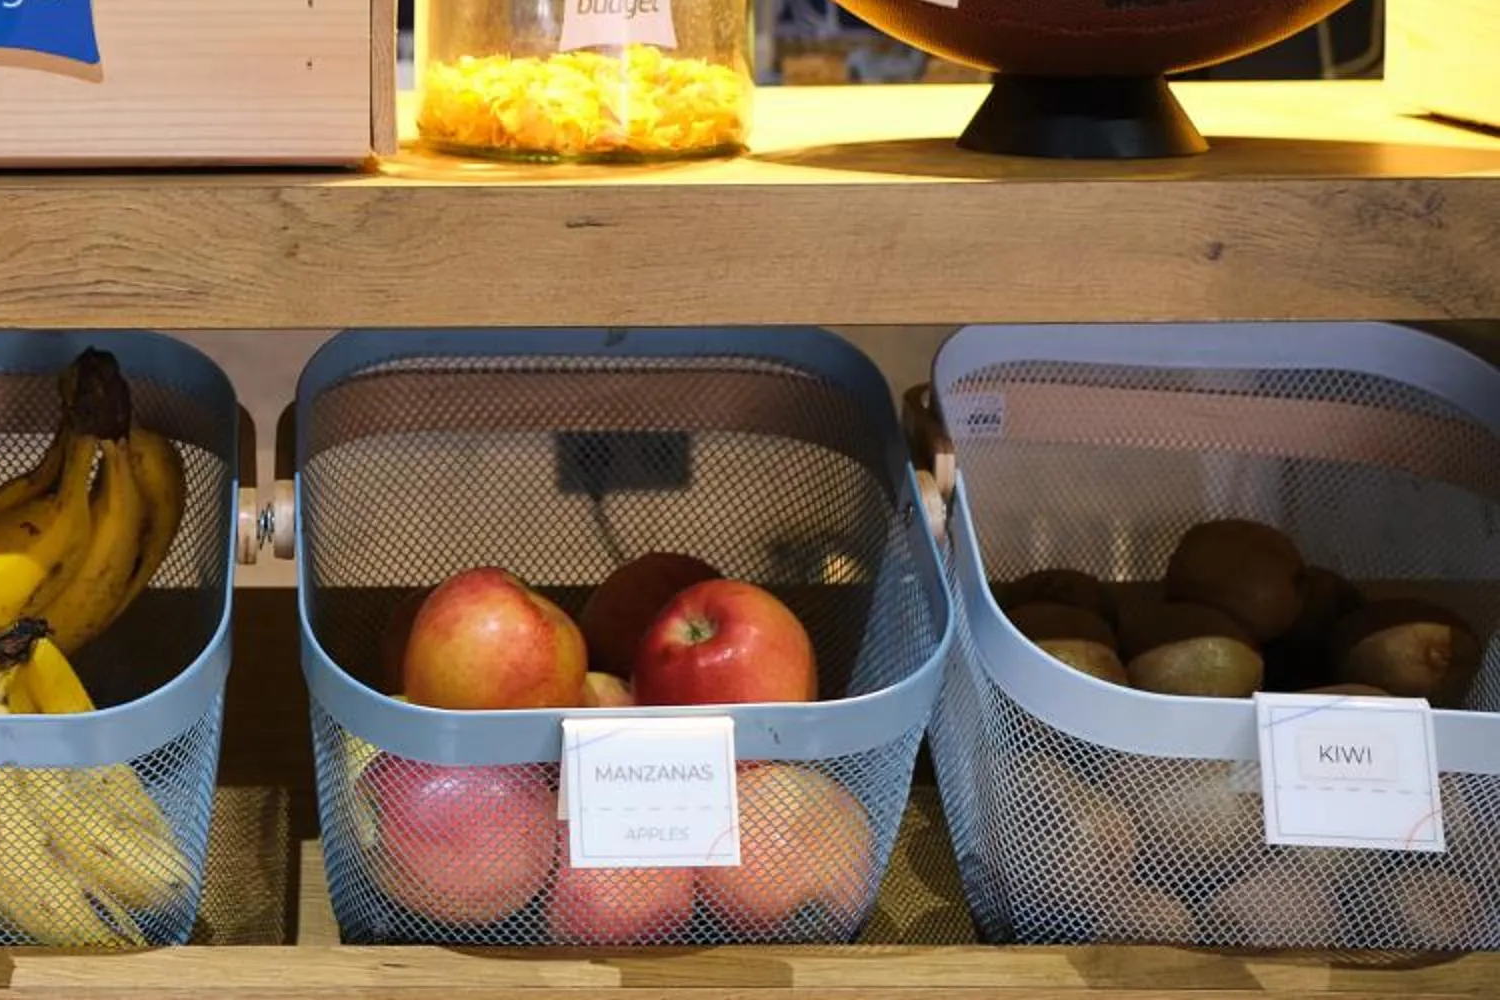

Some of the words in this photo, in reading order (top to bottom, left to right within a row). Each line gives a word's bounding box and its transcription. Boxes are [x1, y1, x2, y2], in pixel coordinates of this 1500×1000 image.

[1318, 744, 1372, 765] KIWI
[594, 763, 714, 783] MANZANAS
[624, 826, 690, 841] APPLES
